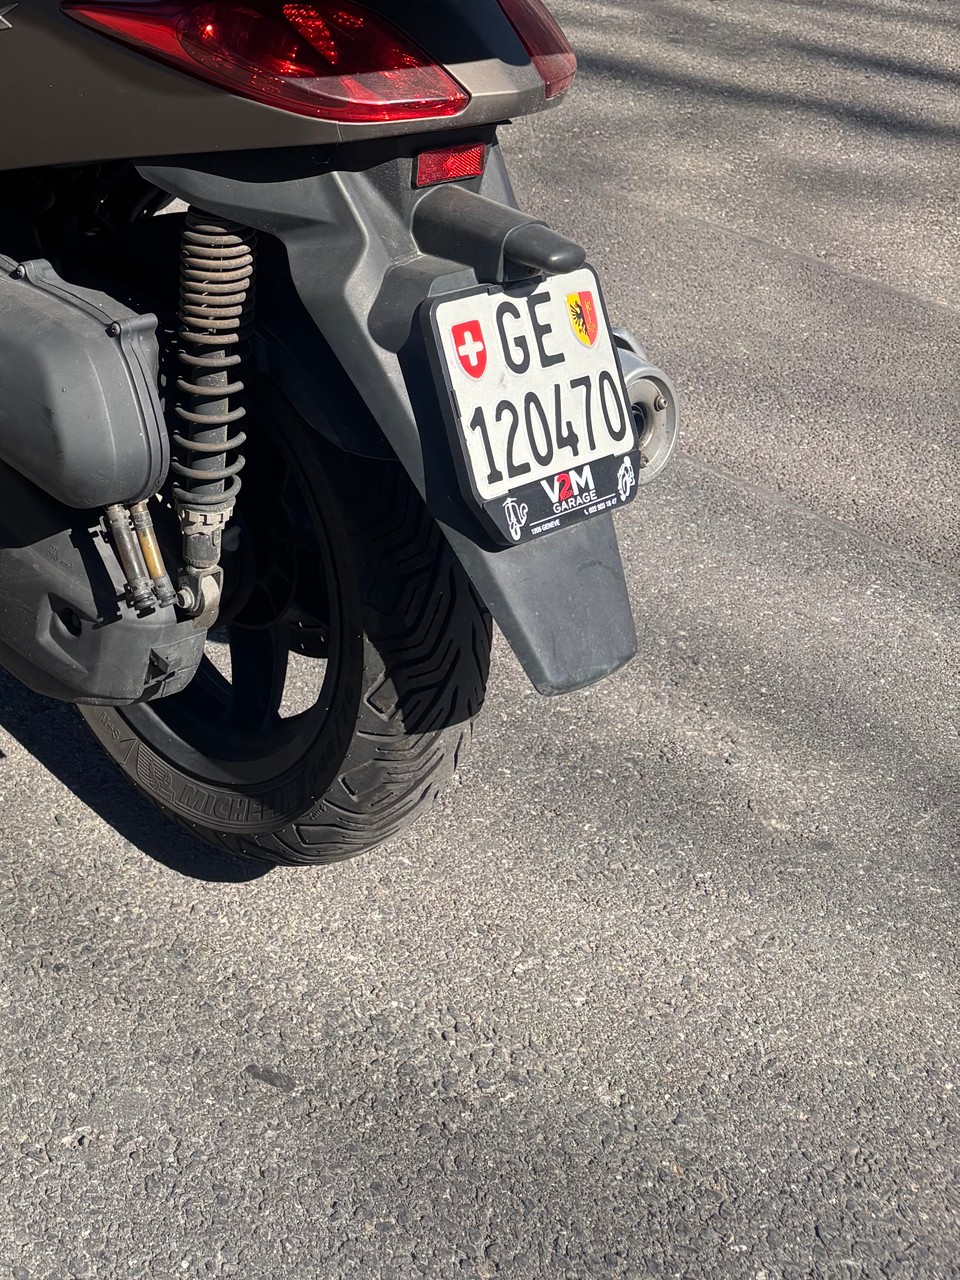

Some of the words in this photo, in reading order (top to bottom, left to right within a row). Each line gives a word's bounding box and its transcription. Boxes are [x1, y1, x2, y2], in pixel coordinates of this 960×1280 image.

[495, 291, 566, 375] GE
[469, 370, 627, 485] 120470
[540, 464, 595, 504] V2M
[553, 490, 597, 513] GARAGE
[178, 780, 300, 822] MICHELIN
